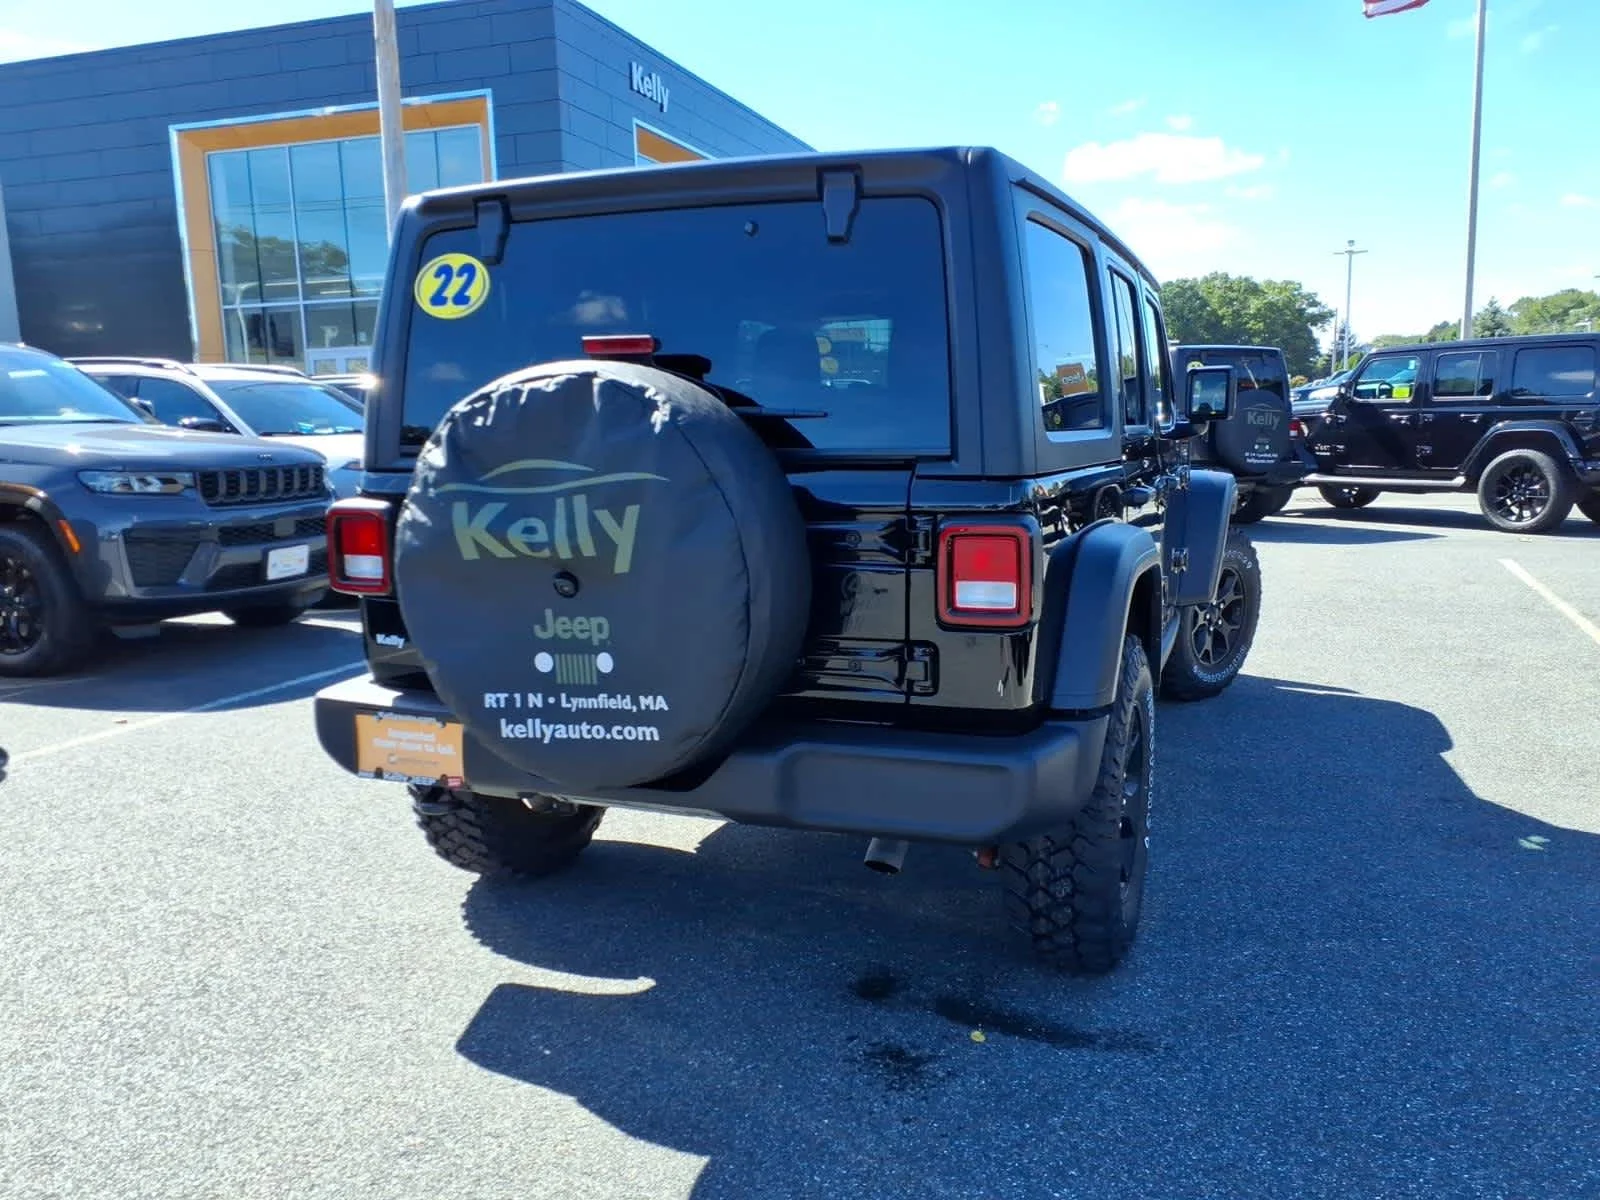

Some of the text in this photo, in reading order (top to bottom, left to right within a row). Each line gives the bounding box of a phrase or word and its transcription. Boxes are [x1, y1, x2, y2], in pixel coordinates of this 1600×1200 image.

[631, 61, 670, 112] Kelly
[429, 262, 477, 307] 22
[452, 494, 640, 574] Kelly
[533, 608, 610, 646] Jeep
[484, 692, 669, 713] RT 1 N Lynnfield, MA
[500, 718, 660, 744] kellyauto.com
